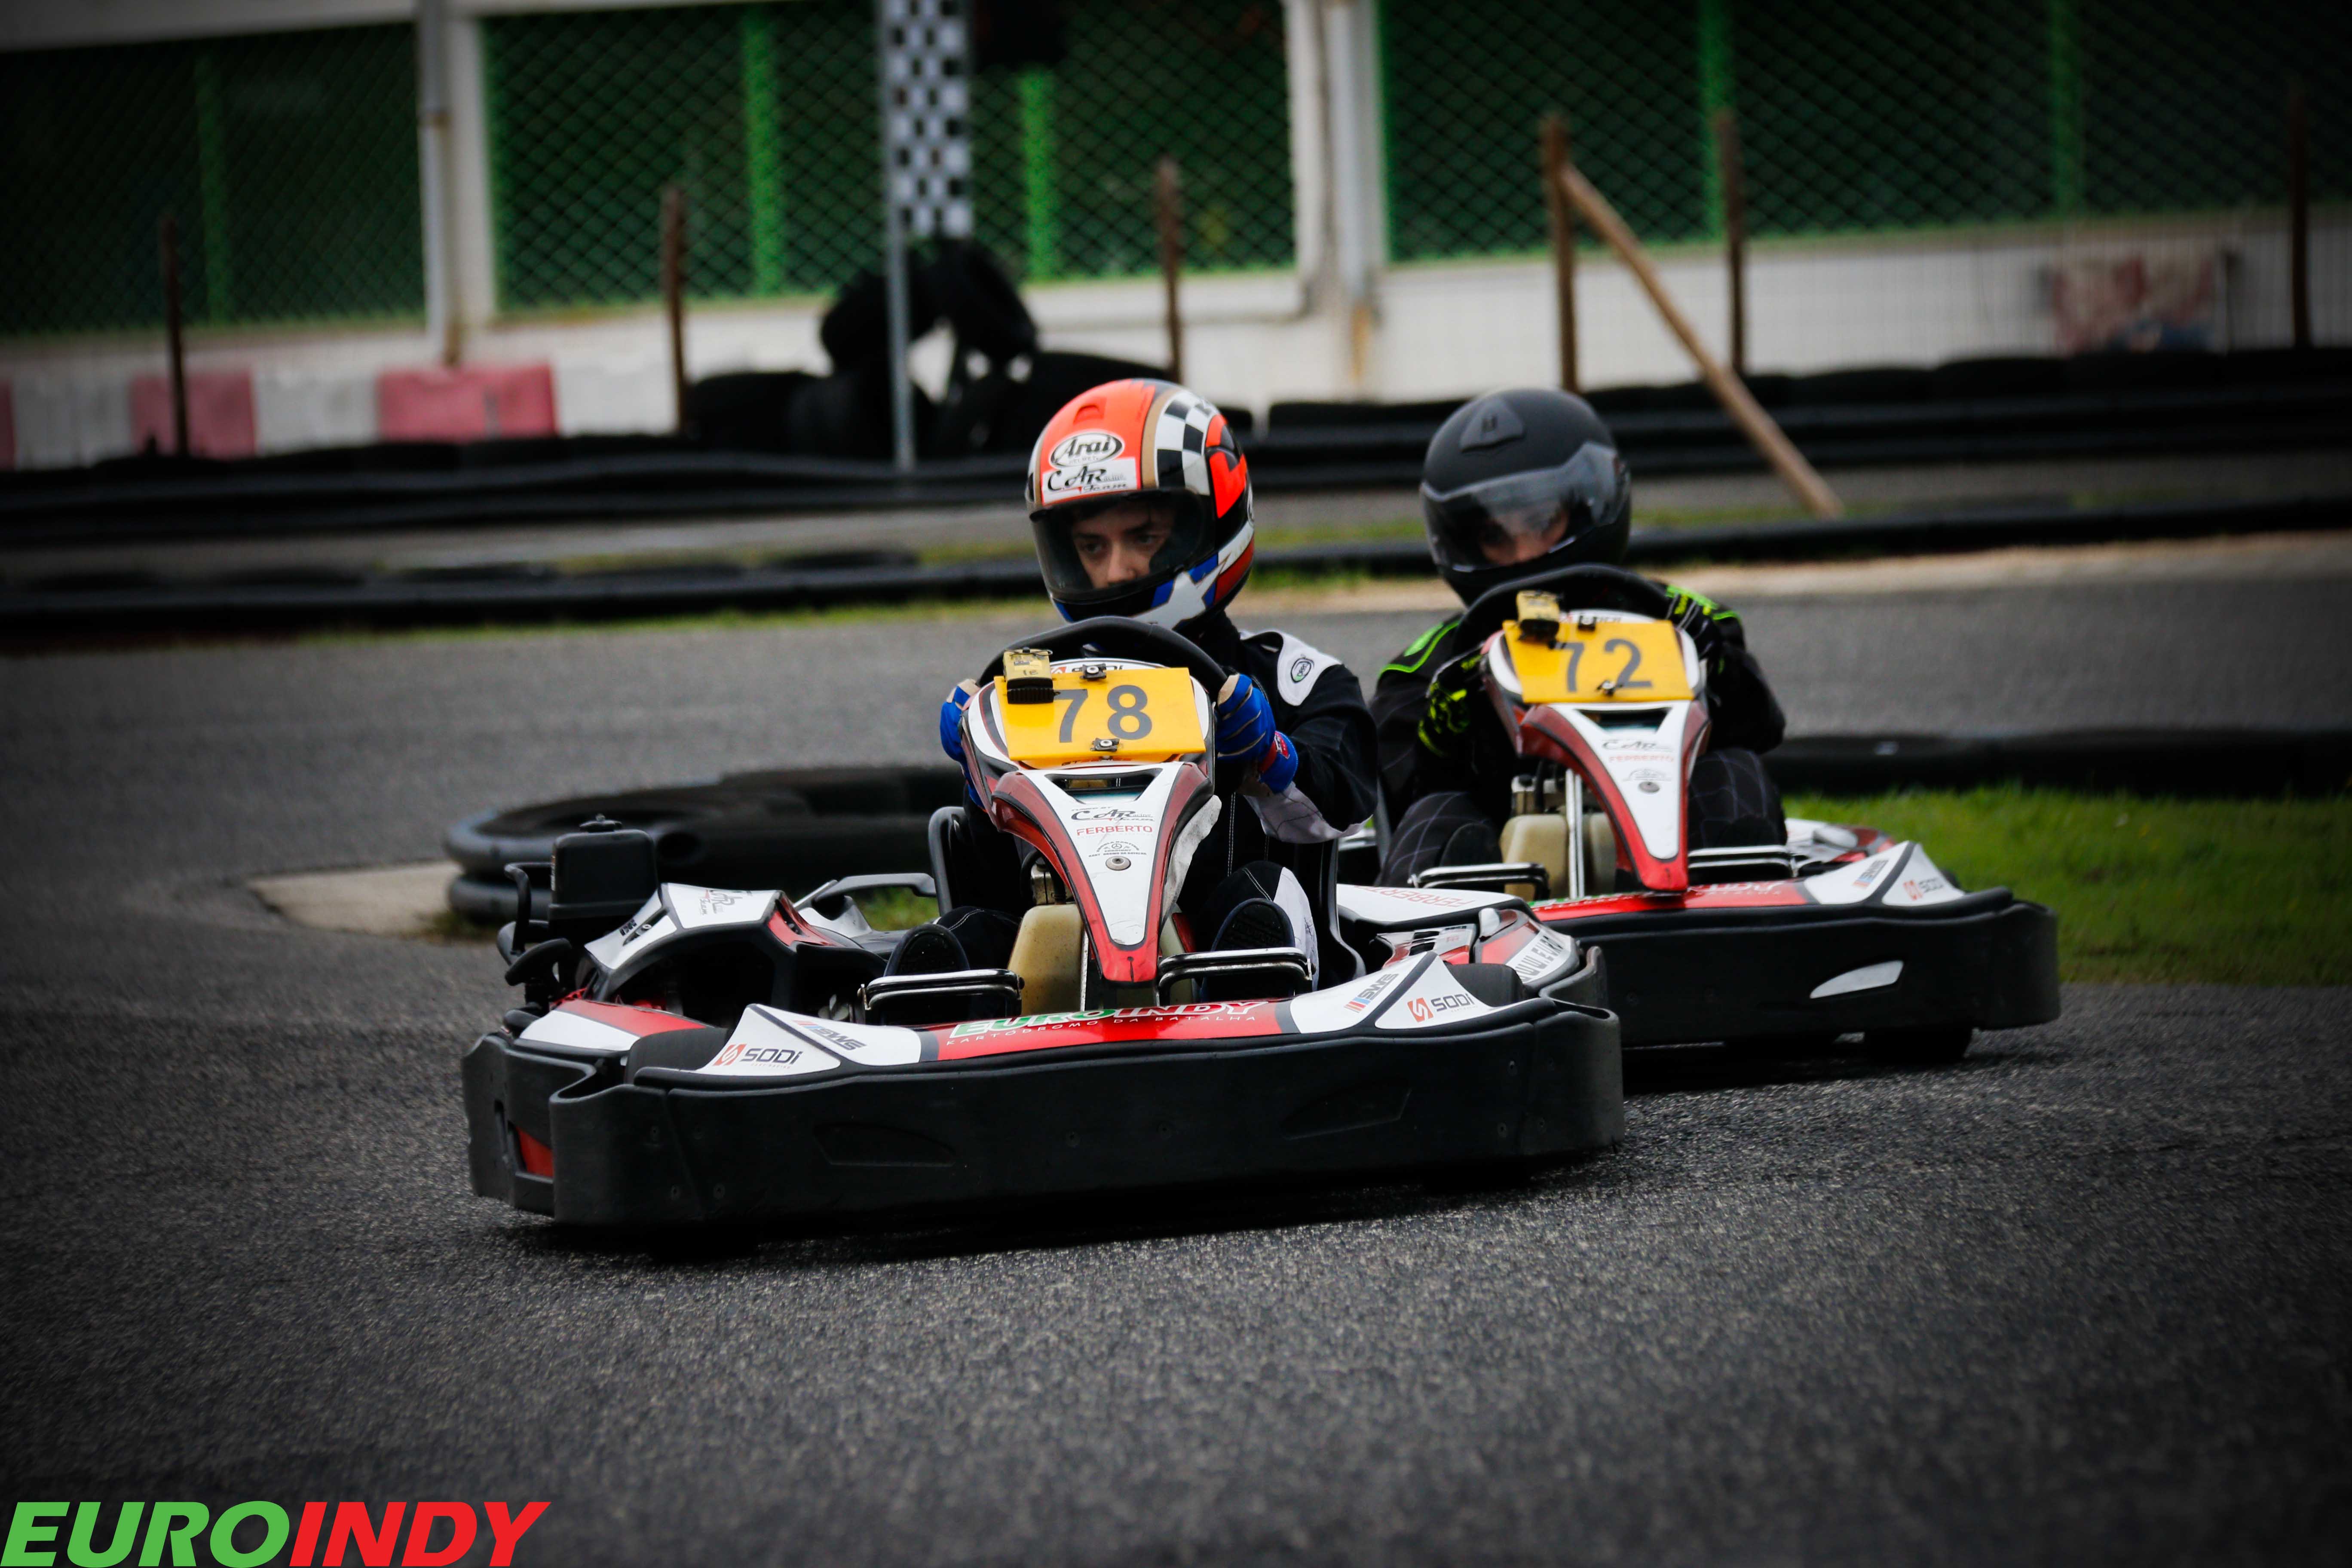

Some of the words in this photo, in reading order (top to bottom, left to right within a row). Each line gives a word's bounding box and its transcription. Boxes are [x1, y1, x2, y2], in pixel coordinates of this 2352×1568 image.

[1053, 436, 1112, 464] Arai
[1553, 638, 1653, 693] 72
[1054, 685, 1152, 743] 78
[1076, 825, 1153, 836] FERBERTO
[1353, 885, 1476, 908] FERBERT
[949, 1001, 1270, 1039] EUROINDY
